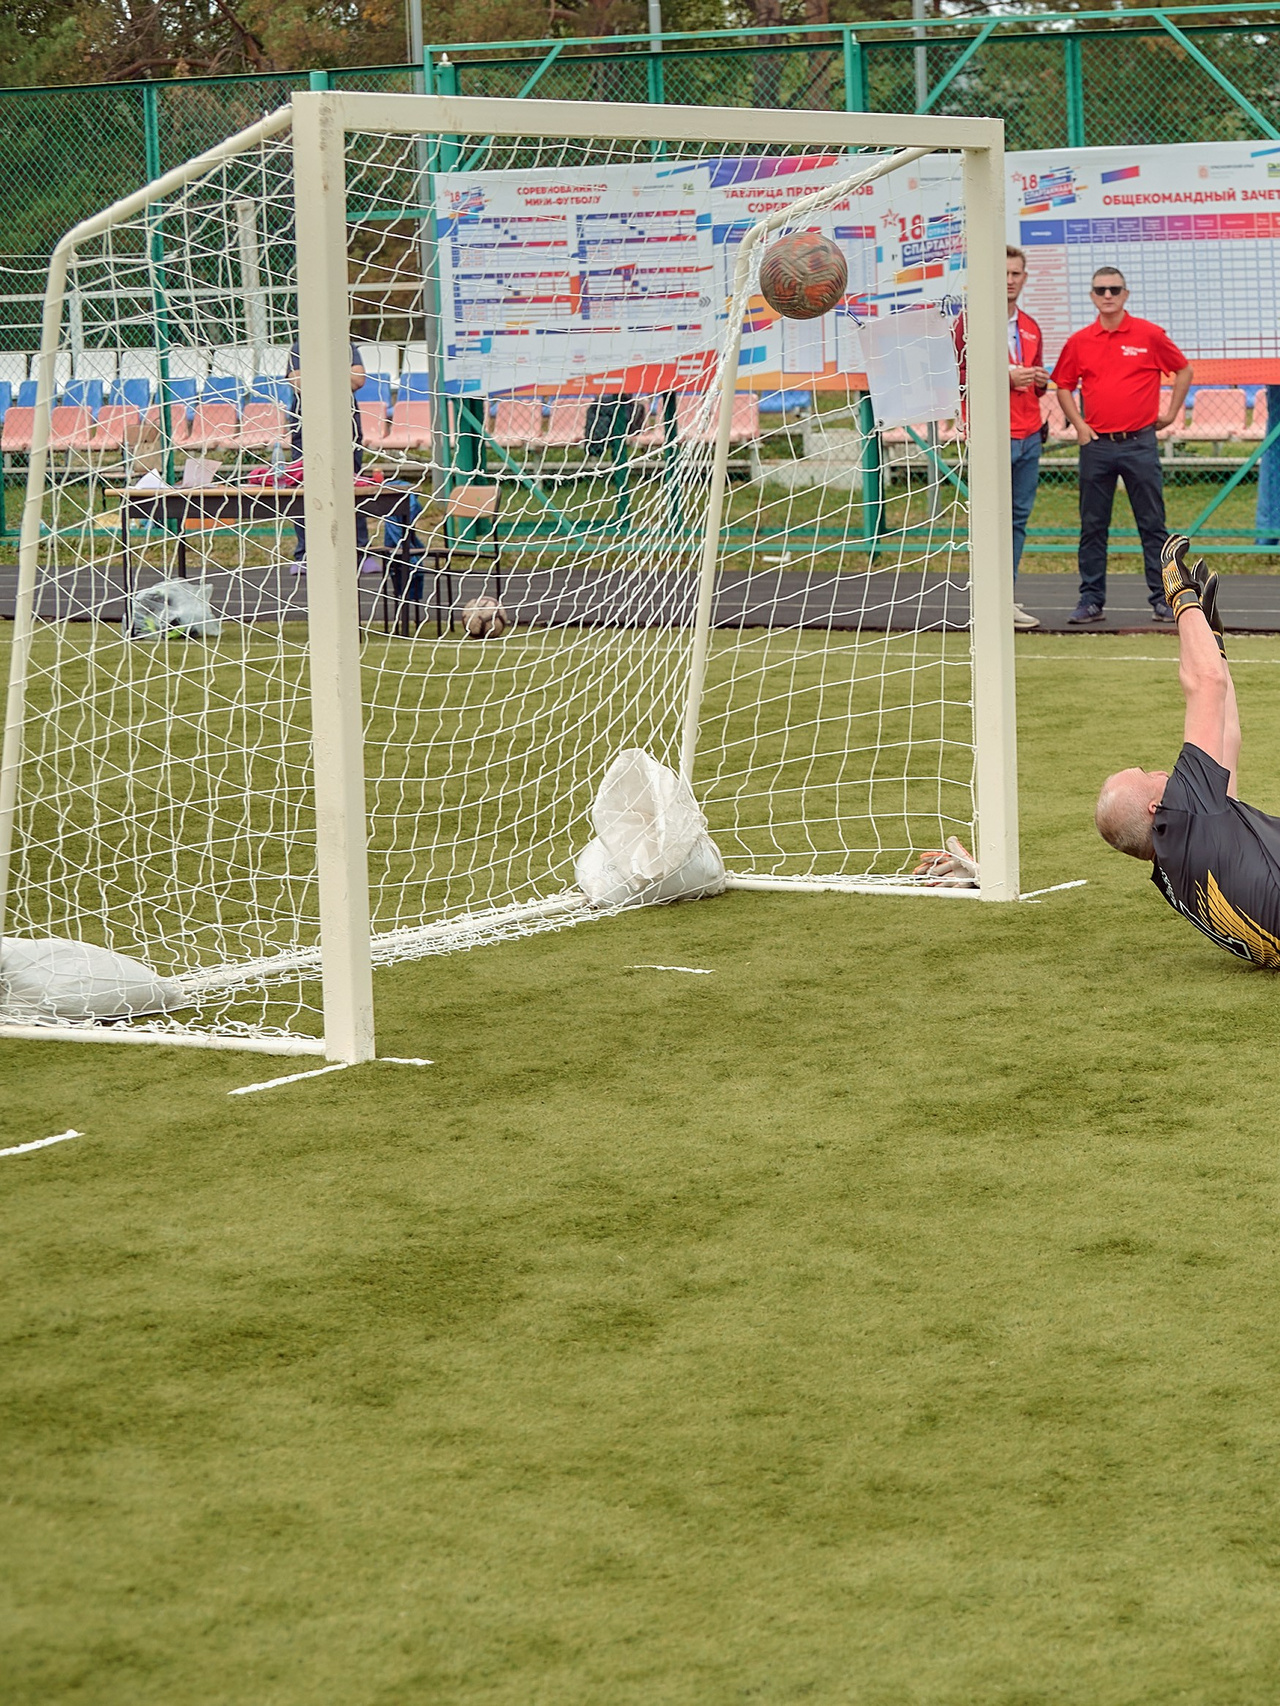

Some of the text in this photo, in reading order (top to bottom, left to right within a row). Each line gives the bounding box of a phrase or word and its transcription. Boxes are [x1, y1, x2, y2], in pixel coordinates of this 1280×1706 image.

[1022, 174, 1038, 191] 18
[723, 187, 783, 199] ТАБЛИЦА
[1102, 188, 1237, 206] ОБЩЕКОМАНДНЫЙ
[898, 214, 925, 243] 18
